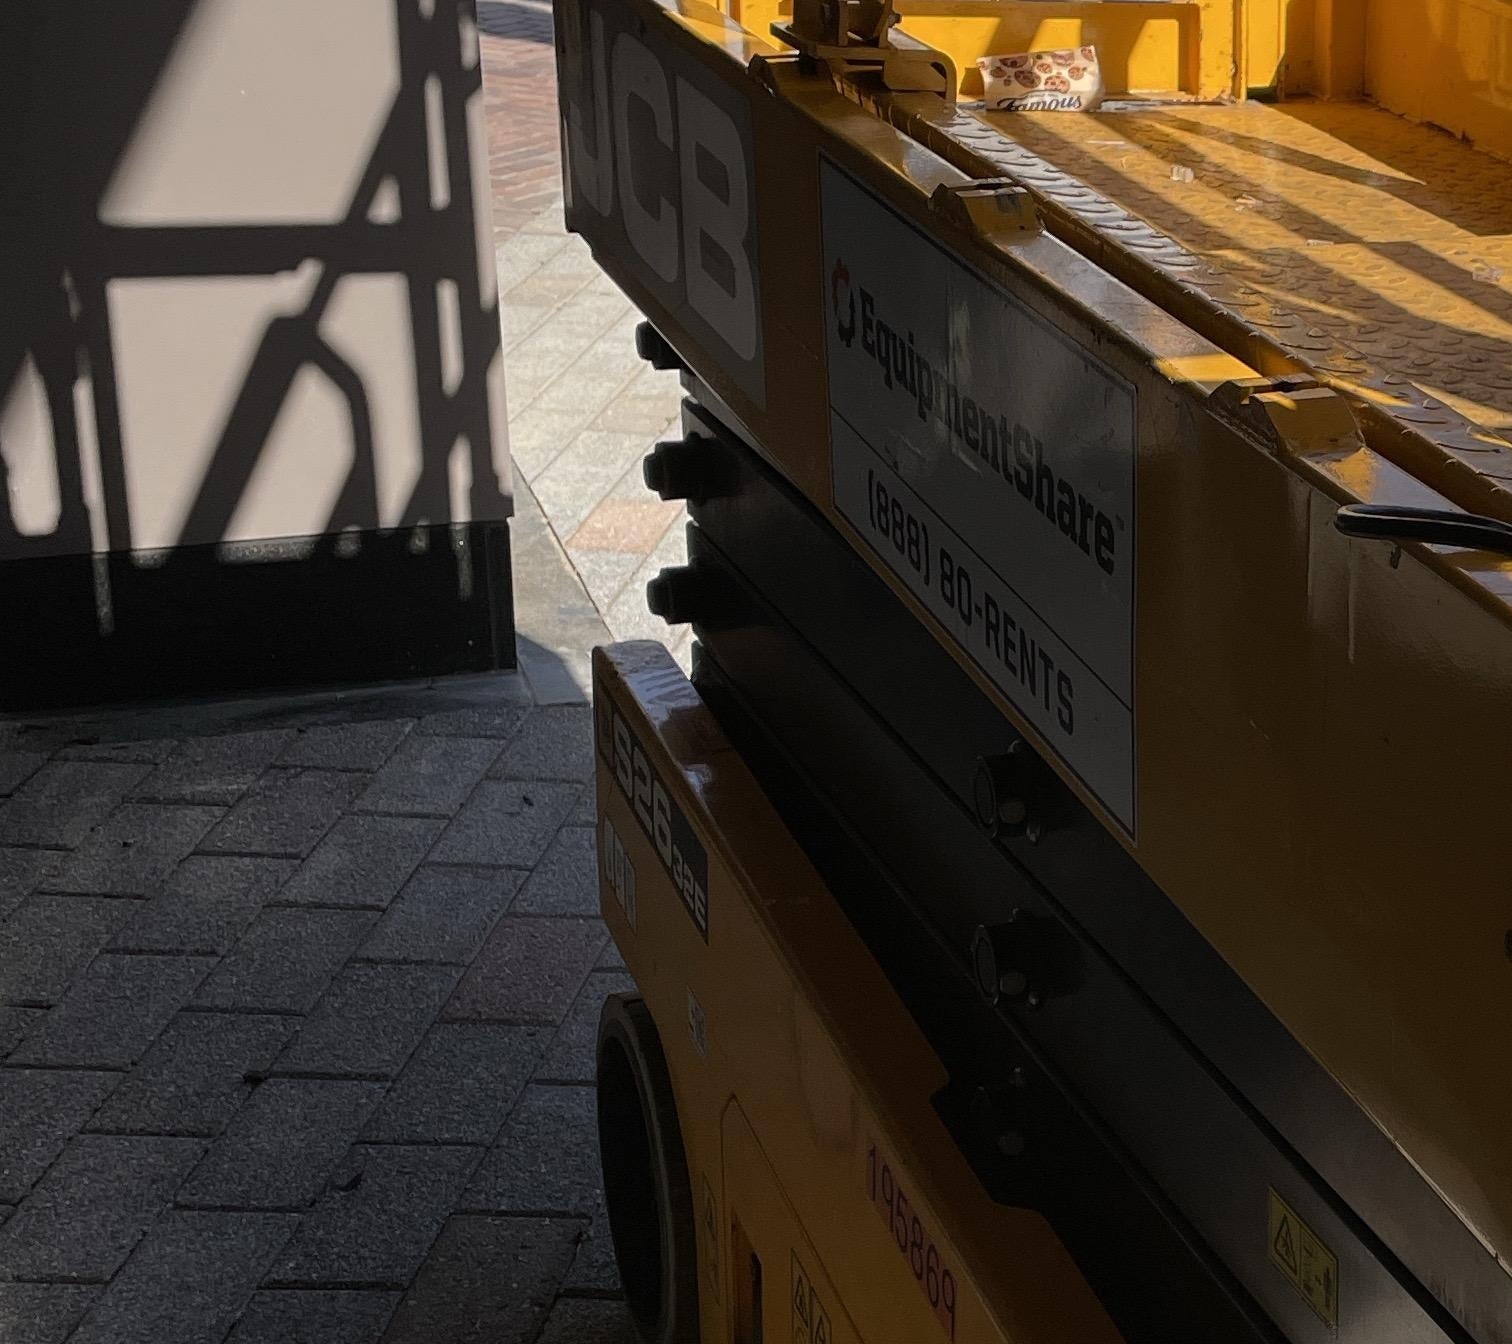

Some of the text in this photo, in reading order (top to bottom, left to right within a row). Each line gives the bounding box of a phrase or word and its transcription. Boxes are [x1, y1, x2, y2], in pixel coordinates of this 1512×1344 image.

[570, 9, 756, 361] JCB
[858, 287, 1116, 578] EquipmentShare
[865, 466, 1075, 738] (888) 80-RENTS
[869, 1143, 955, 1344] 195869
